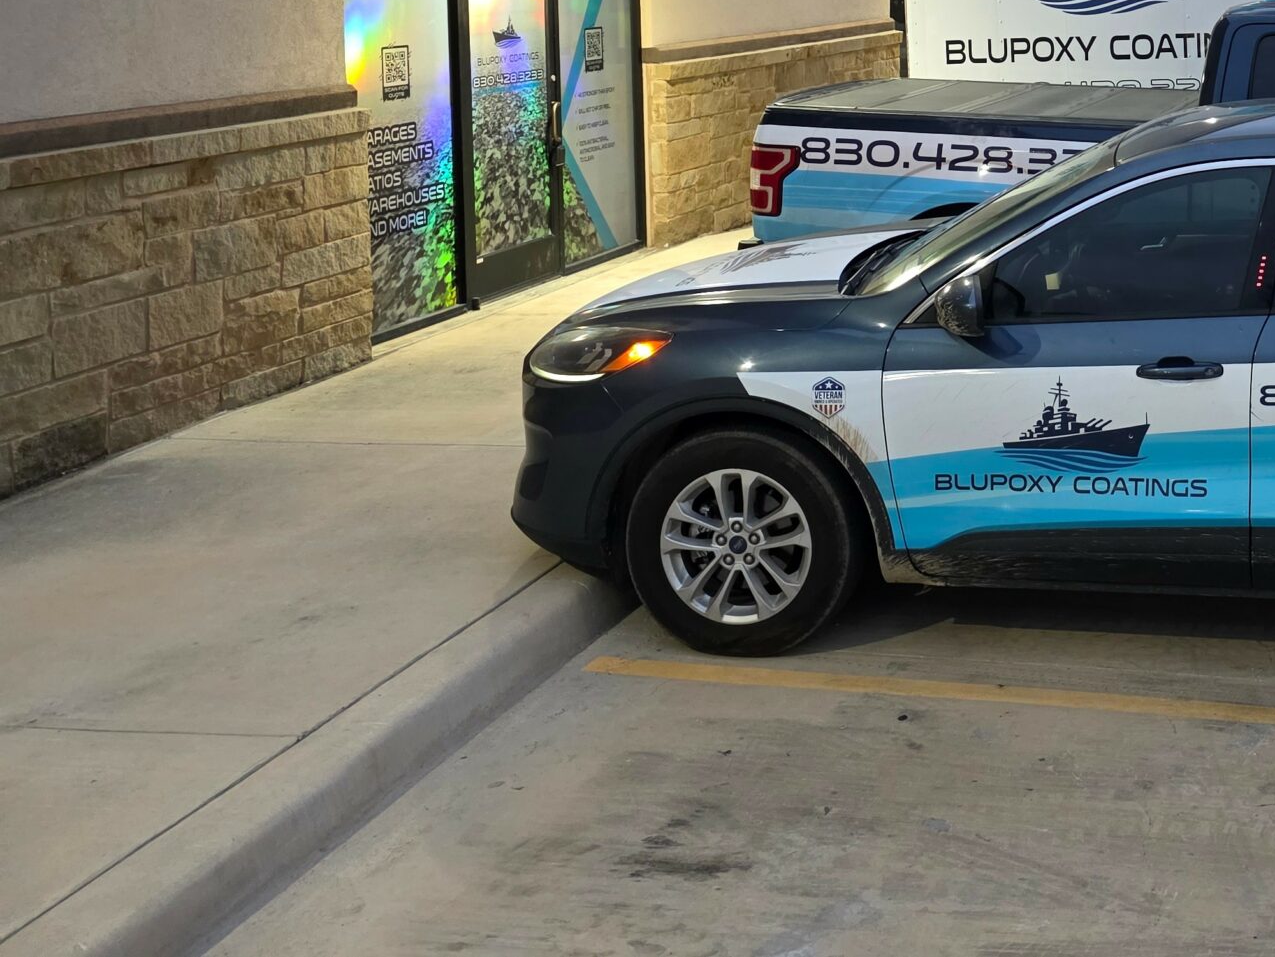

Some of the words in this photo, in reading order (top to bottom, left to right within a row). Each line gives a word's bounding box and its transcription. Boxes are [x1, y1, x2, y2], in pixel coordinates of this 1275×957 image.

[477, 55, 507, 67] BLUPOXY
[509, 51, 540, 63] COATINGS
[945, 35, 1096, 65] BLUPOXY
[473, 69, 544, 88] 830.428.3233
[367, 124, 416, 145] ARAGES
[367, 142, 433, 168] ASEMENTS
[800, 136, 1083, 176] 830.428.3
[368, 171, 402, 192] ATIOS
[368, 183, 445, 215] AREHOUSES
[389, 210, 427, 233] MORE!
[814, 391, 843, 400] VETERAN
[934, 473, 1063, 493] BLUPOXY
[1073, 475, 1208, 498] COATINGS
